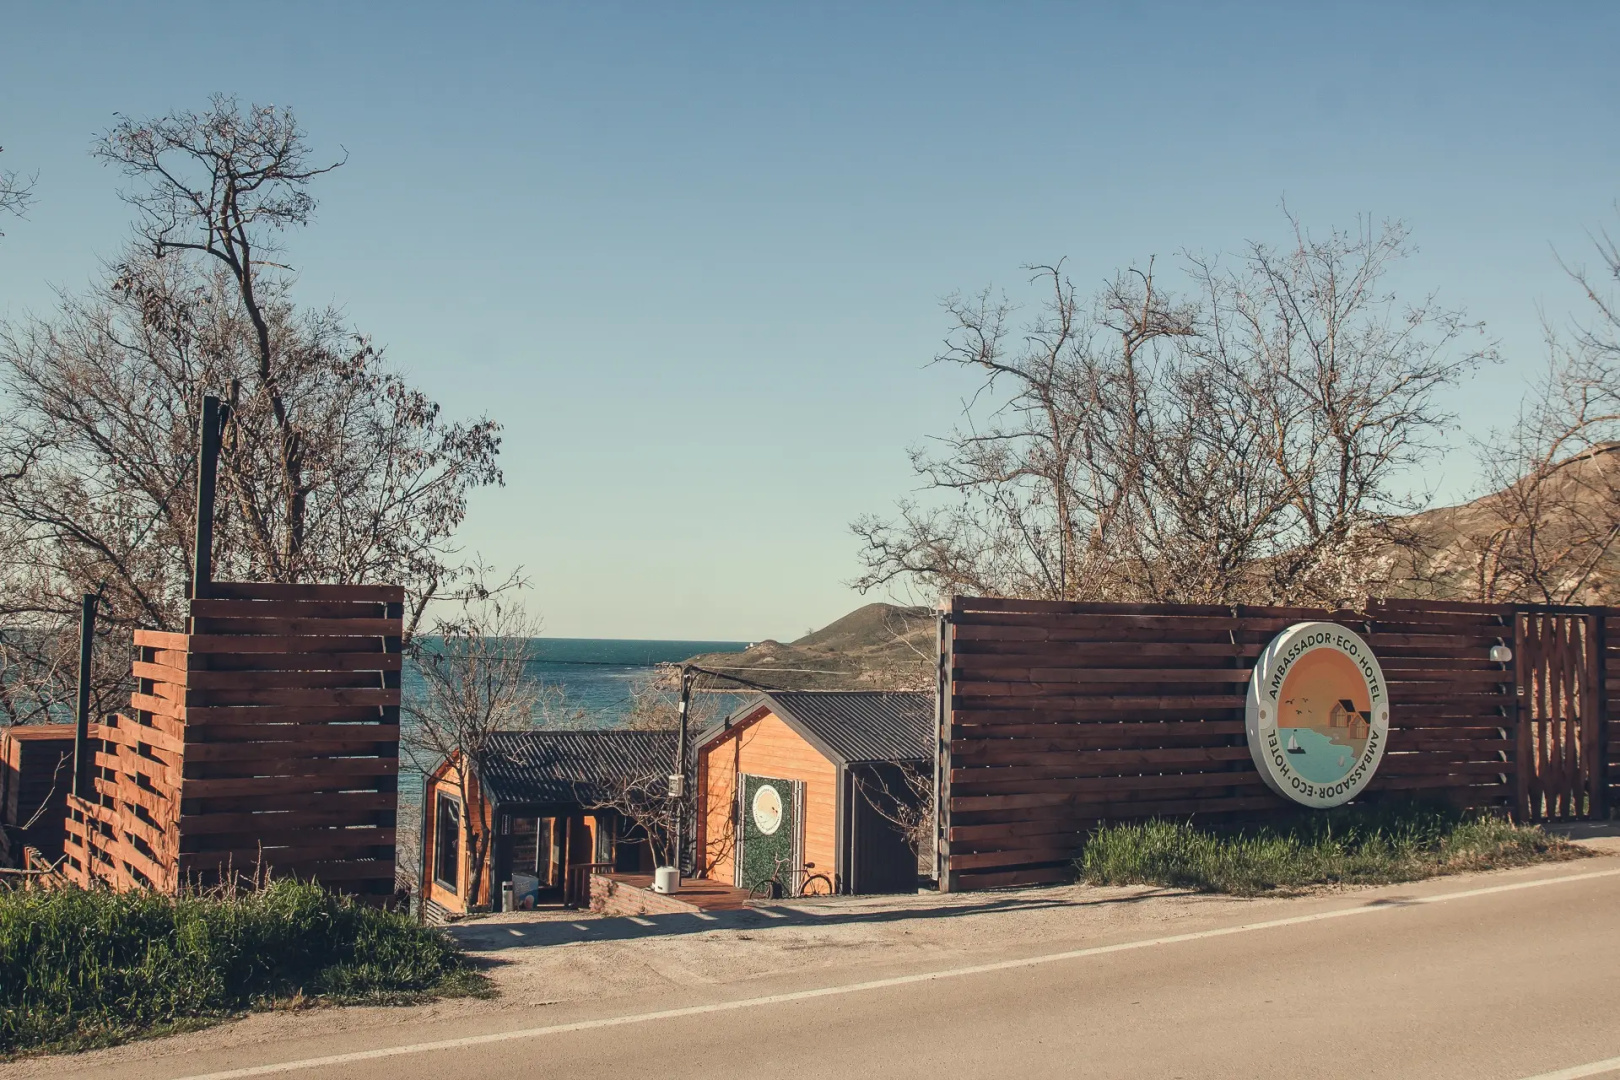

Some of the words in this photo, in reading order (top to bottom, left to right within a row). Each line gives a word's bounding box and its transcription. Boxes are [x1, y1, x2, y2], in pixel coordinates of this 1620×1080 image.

[1269, 633, 1331, 700] AMBASSADOR
[1336, 635, 1357, 655] ECO
[1359, 656, 1380, 702] HOTEL
[1268, 729, 1289, 777] HOTEL
[1319, 730, 1379, 799] AMBASSADOR
[1291, 777, 1313, 797] ECO
